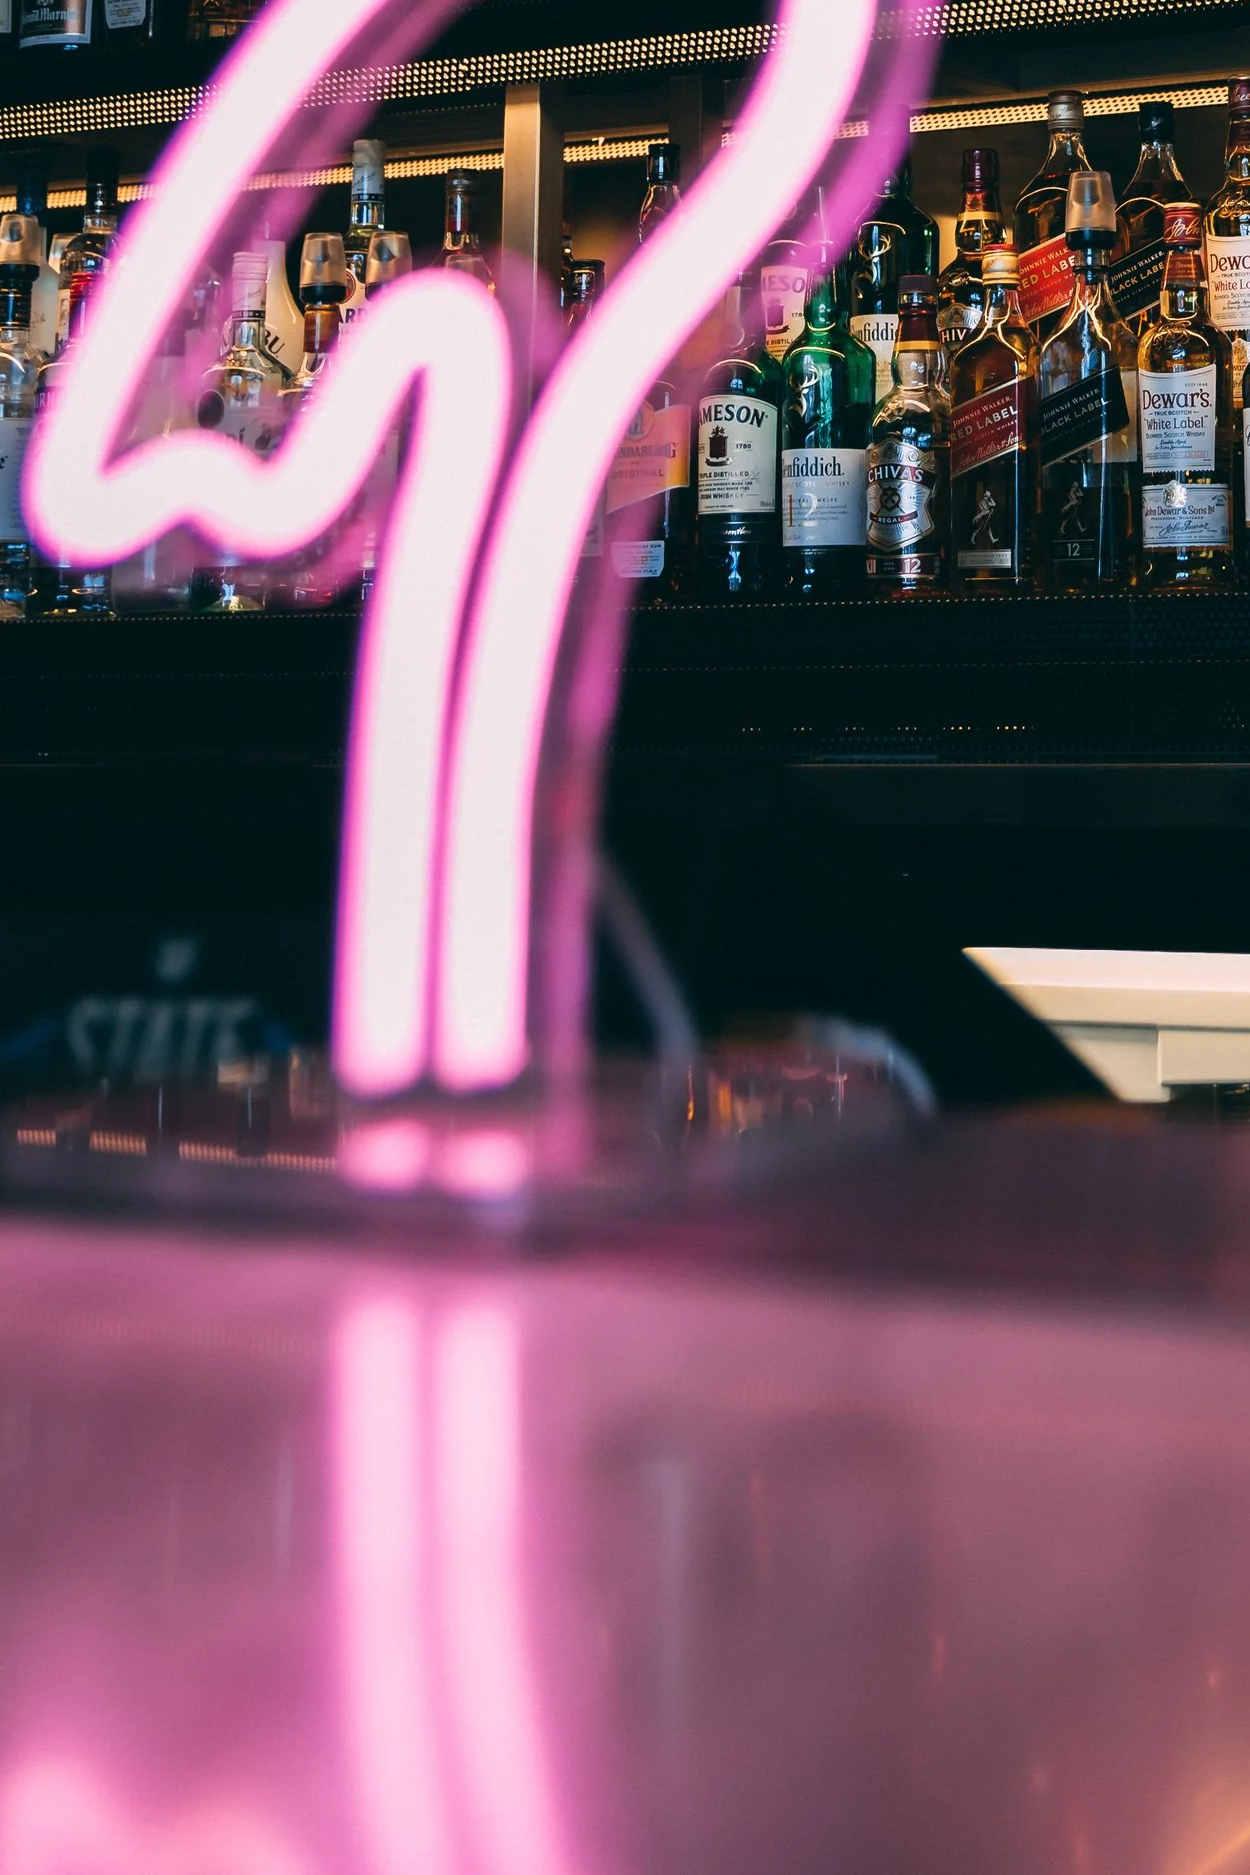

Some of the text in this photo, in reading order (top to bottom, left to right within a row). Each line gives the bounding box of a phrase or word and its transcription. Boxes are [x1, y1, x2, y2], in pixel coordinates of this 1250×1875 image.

[1111, 264, 1138, 285] JOHNNIE
[1042, 401, 1072, 422] JOHNNIE
[1073, 396, 1111, 419] LABEL
[949, 404, 1019, 443] RED LABEL
[952, 409, 981, 430] JOHNNIE
[1163, 431, 1185, 439] SCOTCH
[868, 466, 925, 484] CHIVAS
[877, 515, 903, 523] REGAL
[1157, 504, 1207, 516] Dewar Sons
[1066, 543, 1081, 558] 12
[903, 558, 922, 574] 12
